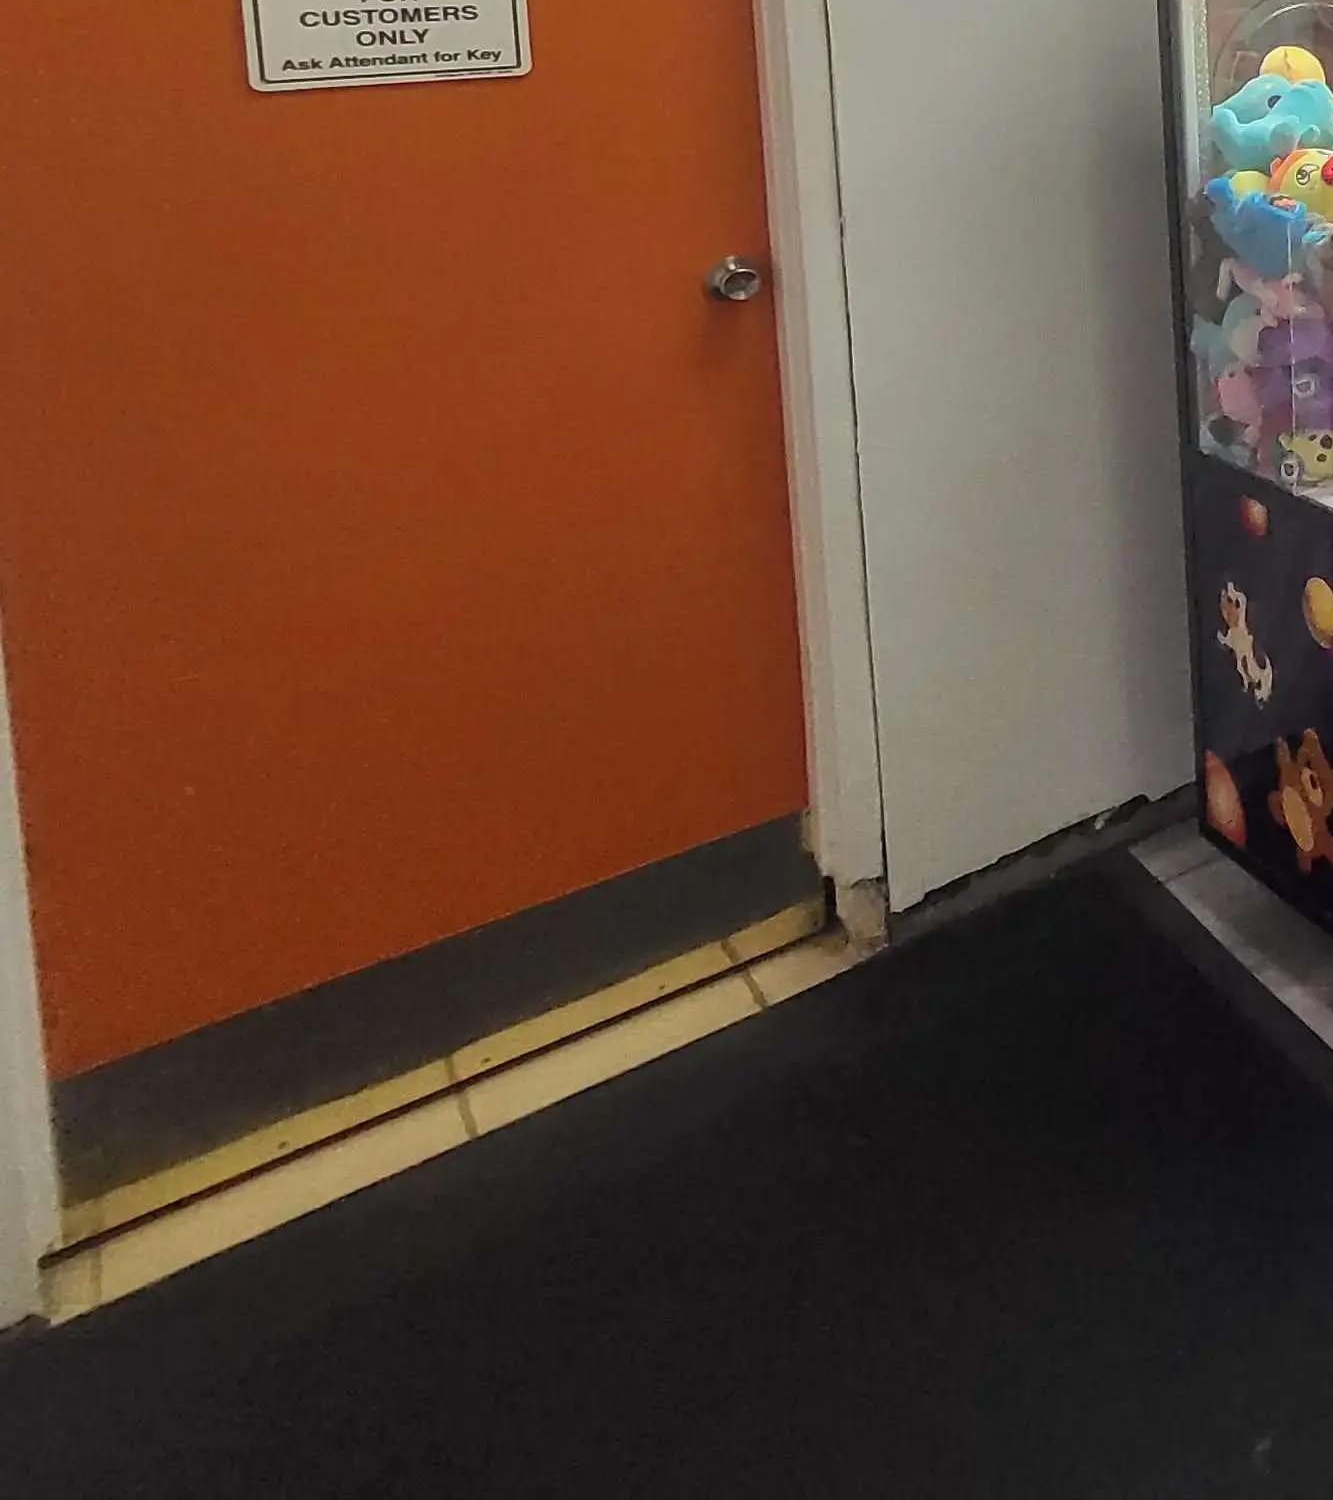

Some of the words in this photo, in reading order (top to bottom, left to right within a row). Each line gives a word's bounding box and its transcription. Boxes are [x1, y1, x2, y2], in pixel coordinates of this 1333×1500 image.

[299, 5, 480, 28] CUSTOMERS
[356, 28, 429, 47] ONLY
[282, 57, 323, 72] Ask
[329, 51, 428, 69] Attendant
[433, 50, 461, 63] for
[467, 47, 502, 65] Key
